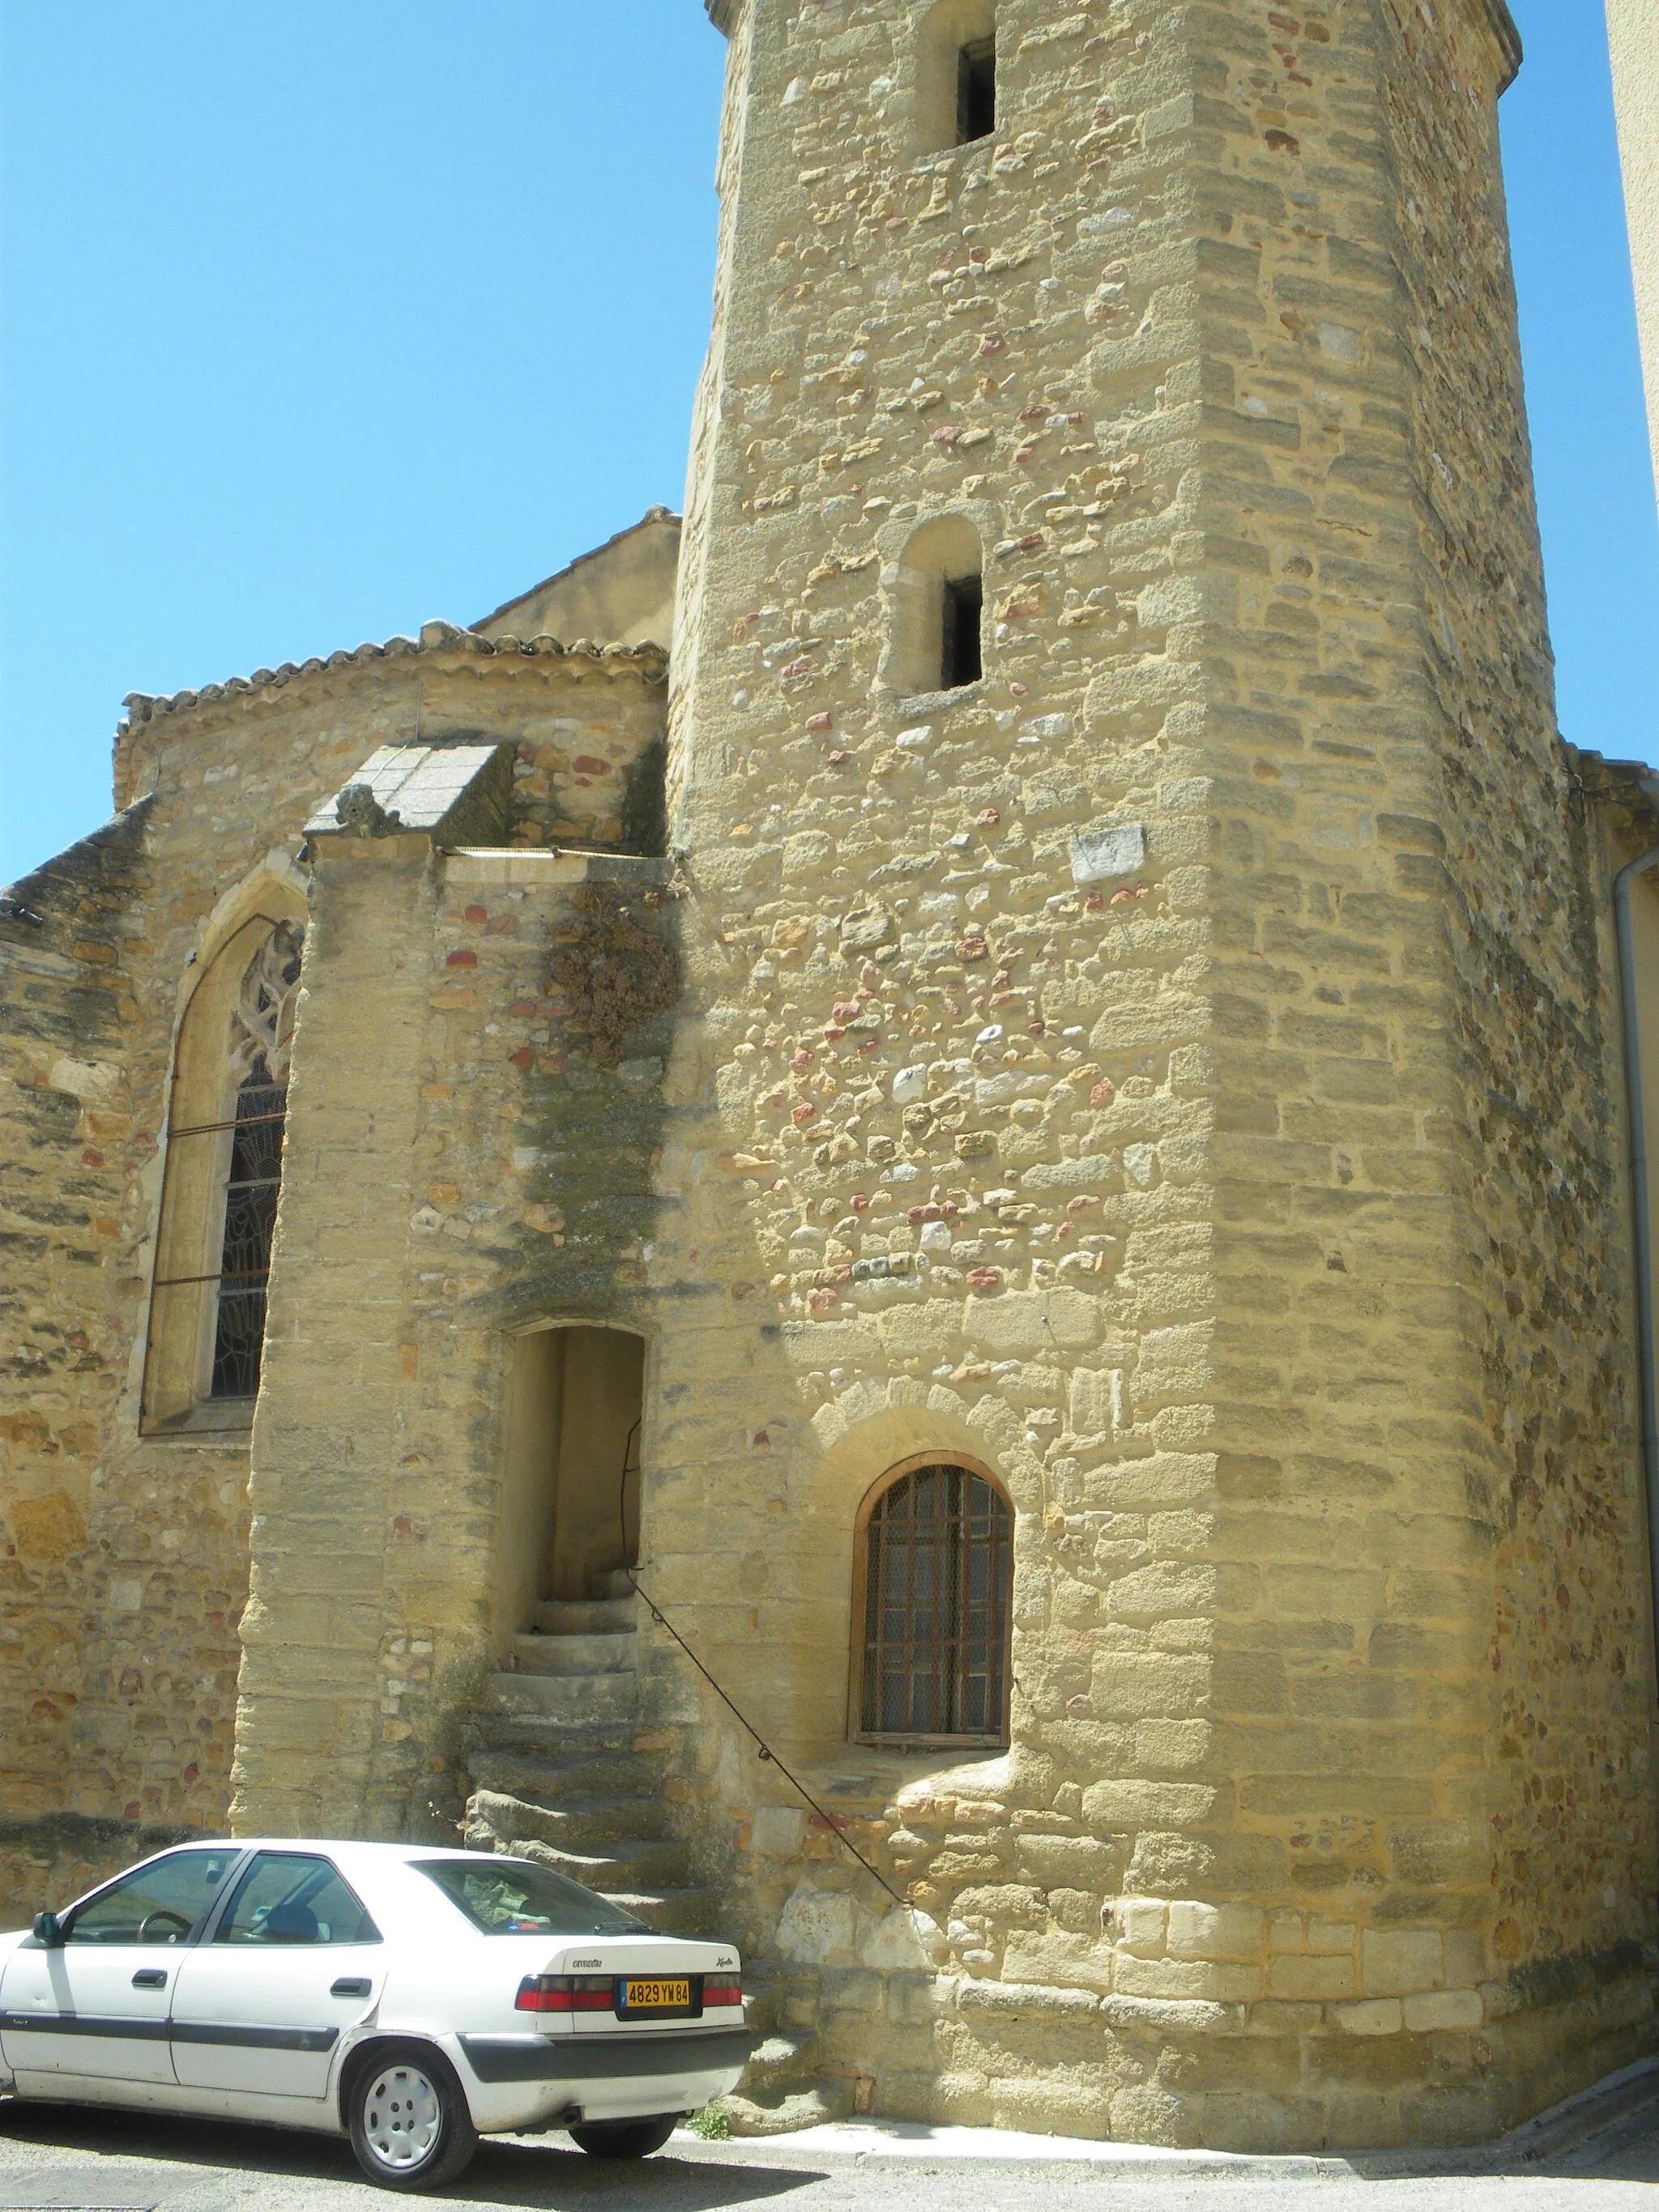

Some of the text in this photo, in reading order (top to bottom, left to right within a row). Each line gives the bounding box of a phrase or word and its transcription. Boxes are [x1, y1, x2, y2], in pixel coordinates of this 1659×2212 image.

[629, 1984, 659, 2002] 4829
[661, 1984, 674, 2002] YW
[676, 1984, 688, 2001] 84
